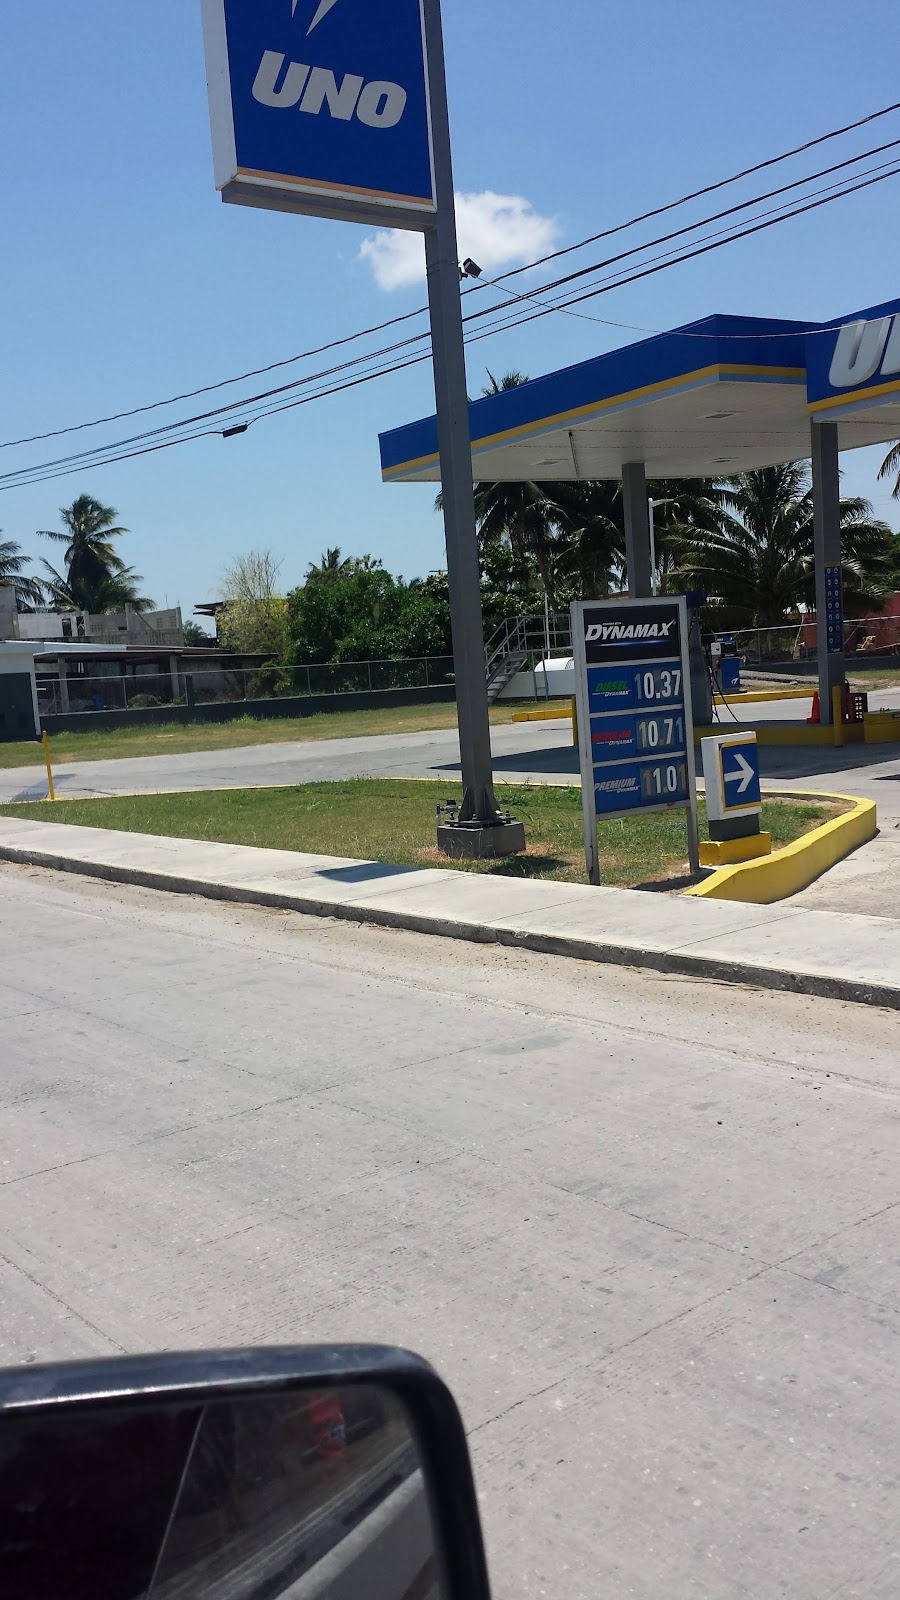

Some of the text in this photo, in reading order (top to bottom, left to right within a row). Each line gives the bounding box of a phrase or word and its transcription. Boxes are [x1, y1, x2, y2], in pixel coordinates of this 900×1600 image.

[251, 50, 407, 128] UNO
[585, 619, 674, 640] DYNAMAX
[595, 681, 628, 692] DIESEL
[634, 669, 681, 699] 10.37
[639, 717, 684, 747] 10.71
[594, 777, 636, 791] PREMIUM
[642, 764, 687, 796] 11.01
